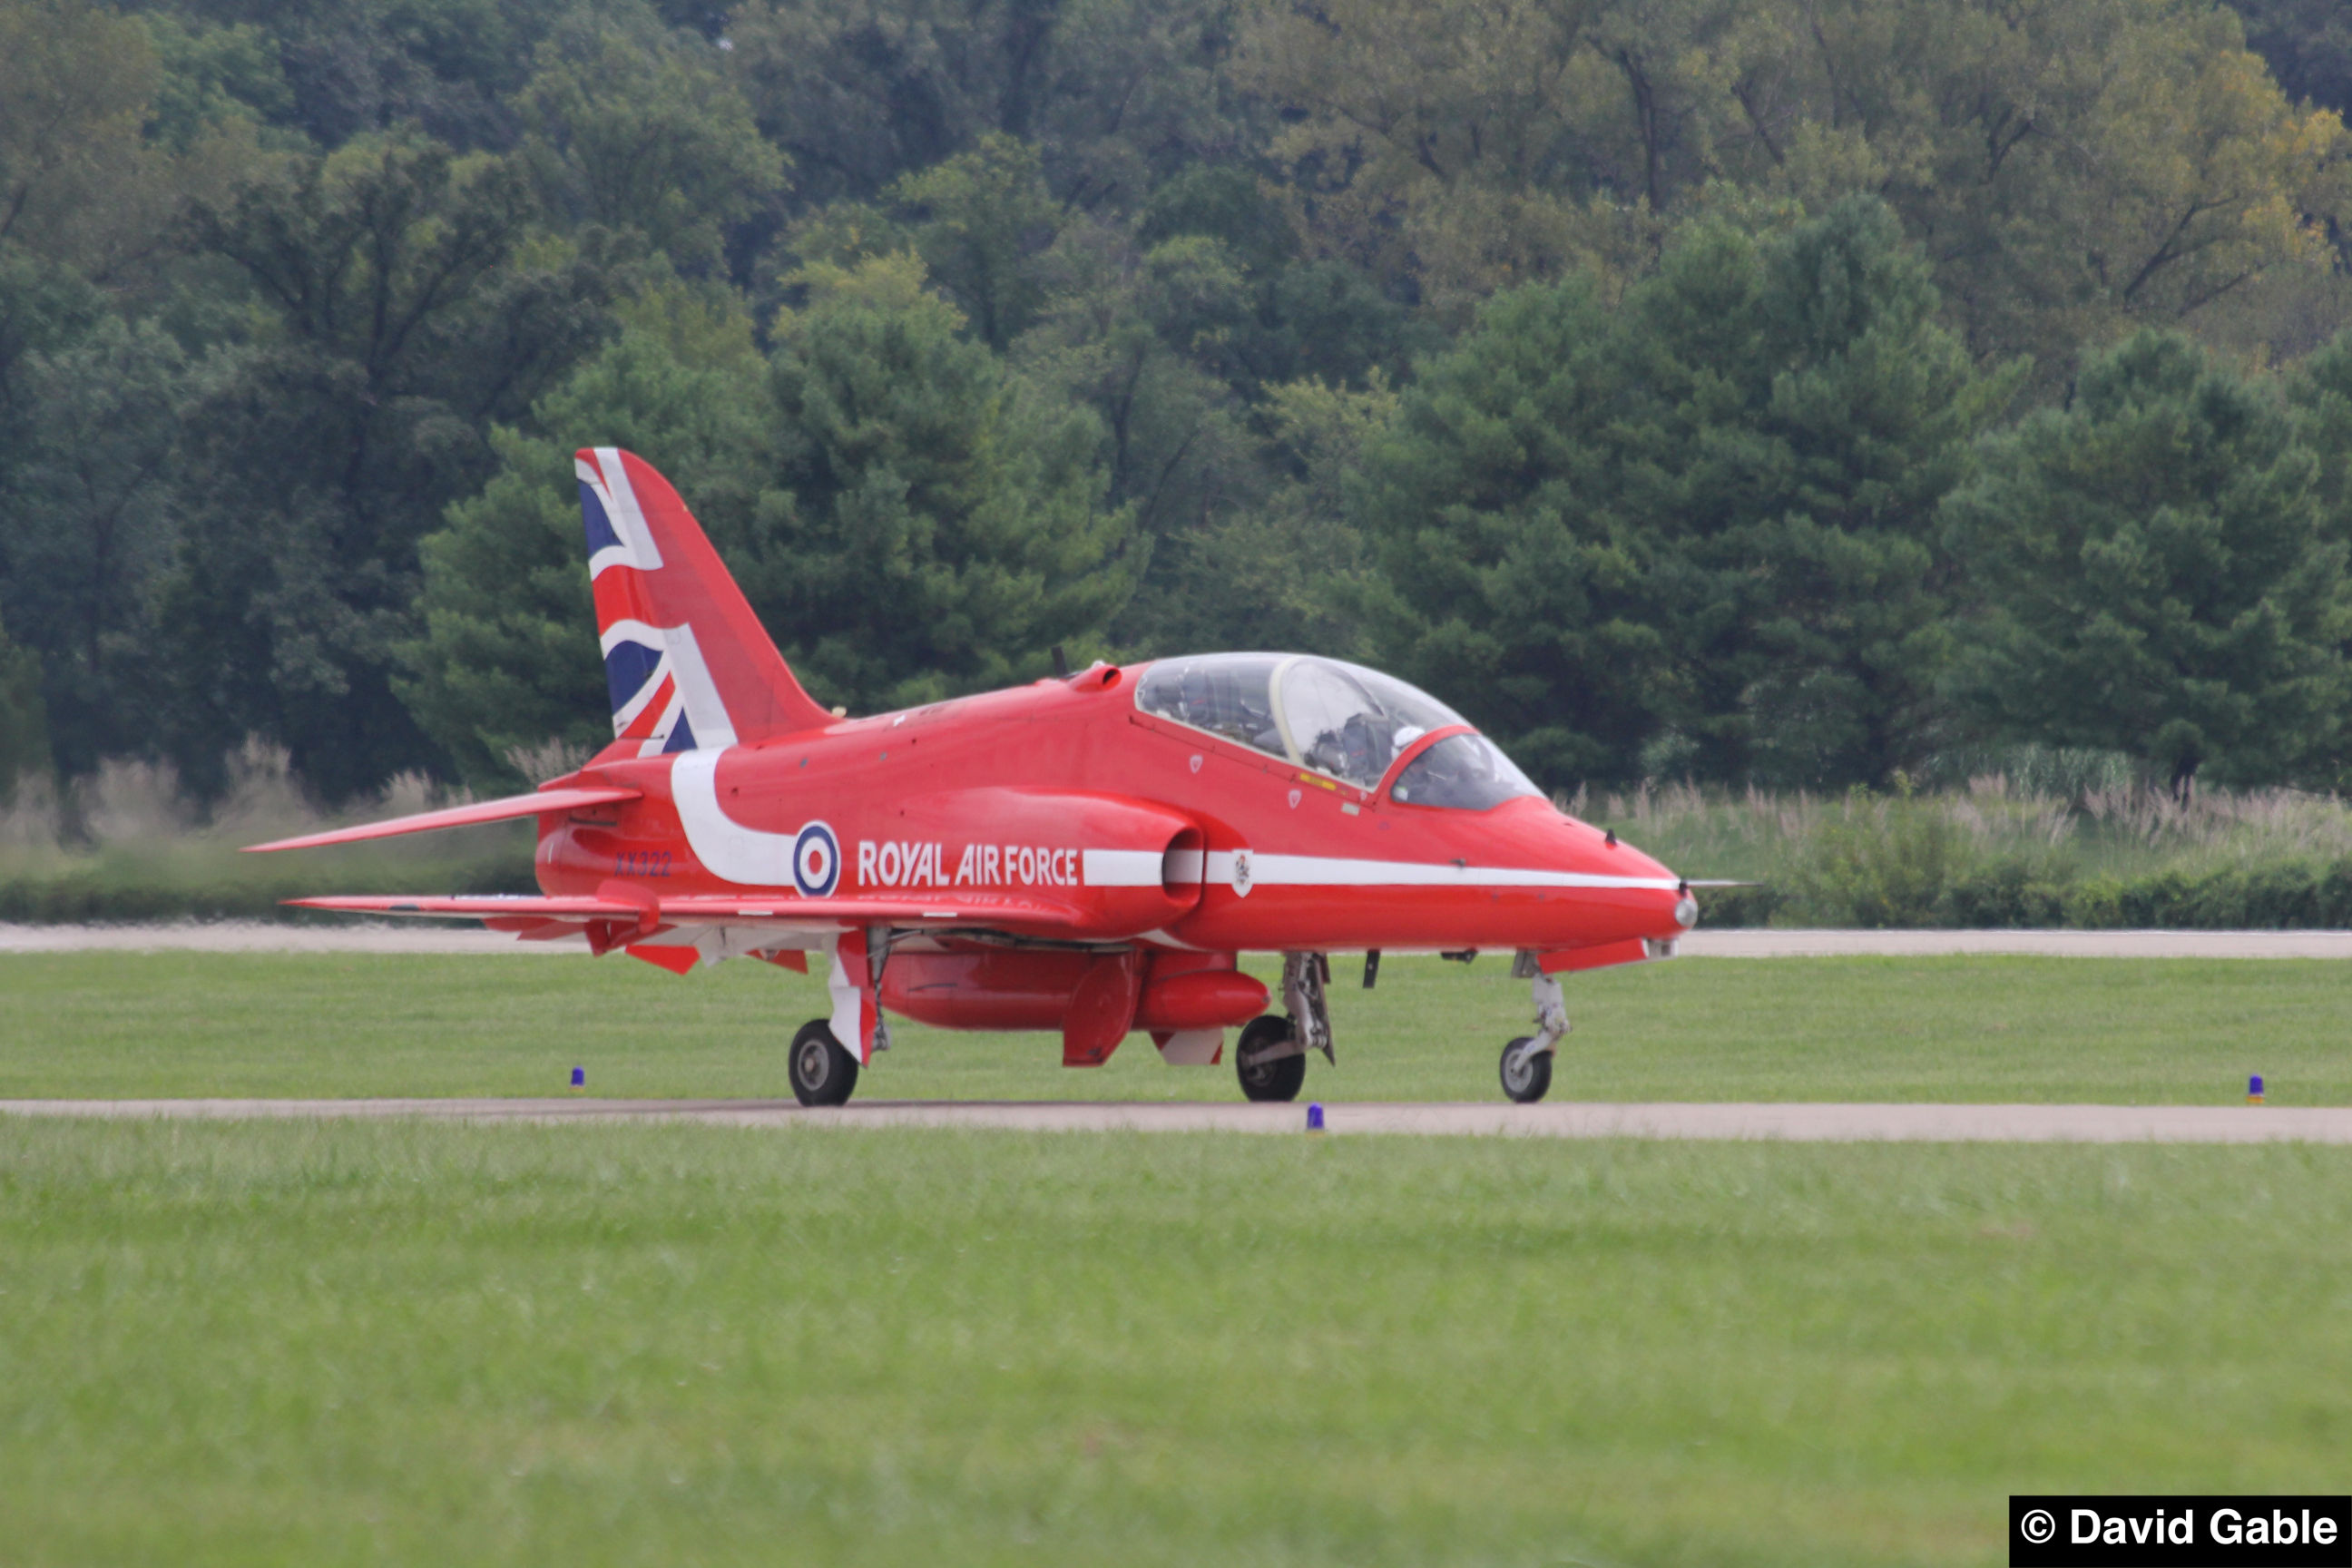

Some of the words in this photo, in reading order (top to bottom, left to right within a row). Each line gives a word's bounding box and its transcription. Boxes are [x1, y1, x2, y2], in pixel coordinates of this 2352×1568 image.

[614, 849, 672, 877] XX322
[858, 840, 950, 887] ROYAL
[955, 843, 1001, 886] AIR
[1004, 845, 1078, 886] FORCE
